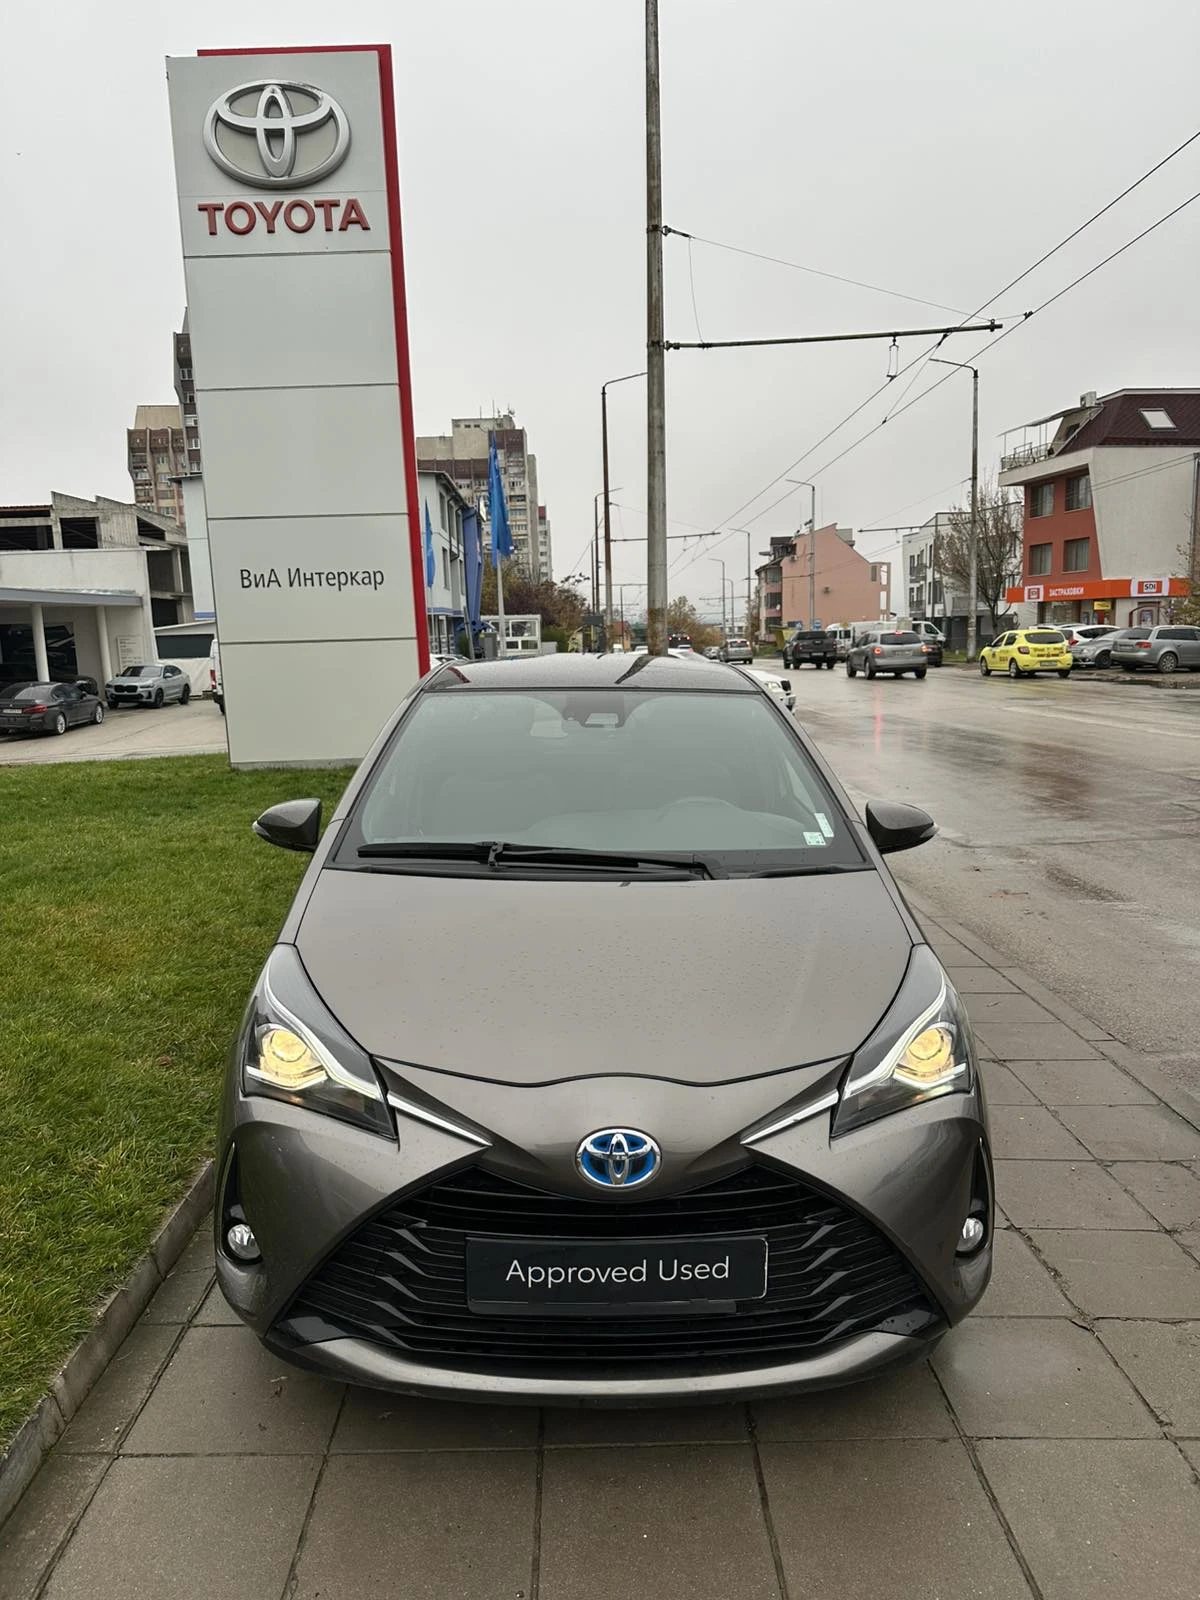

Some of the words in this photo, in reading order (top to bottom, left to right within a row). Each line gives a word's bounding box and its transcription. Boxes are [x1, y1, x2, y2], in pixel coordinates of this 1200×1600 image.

[197, 199, 371, 236] TOYOTA
[240, 568, 282, 589] ВиА
[287, 567, 385, 592] Интеркар
[505, 1259, 647, 1289] Approved
[658, 1255, 730, 1281] Used
